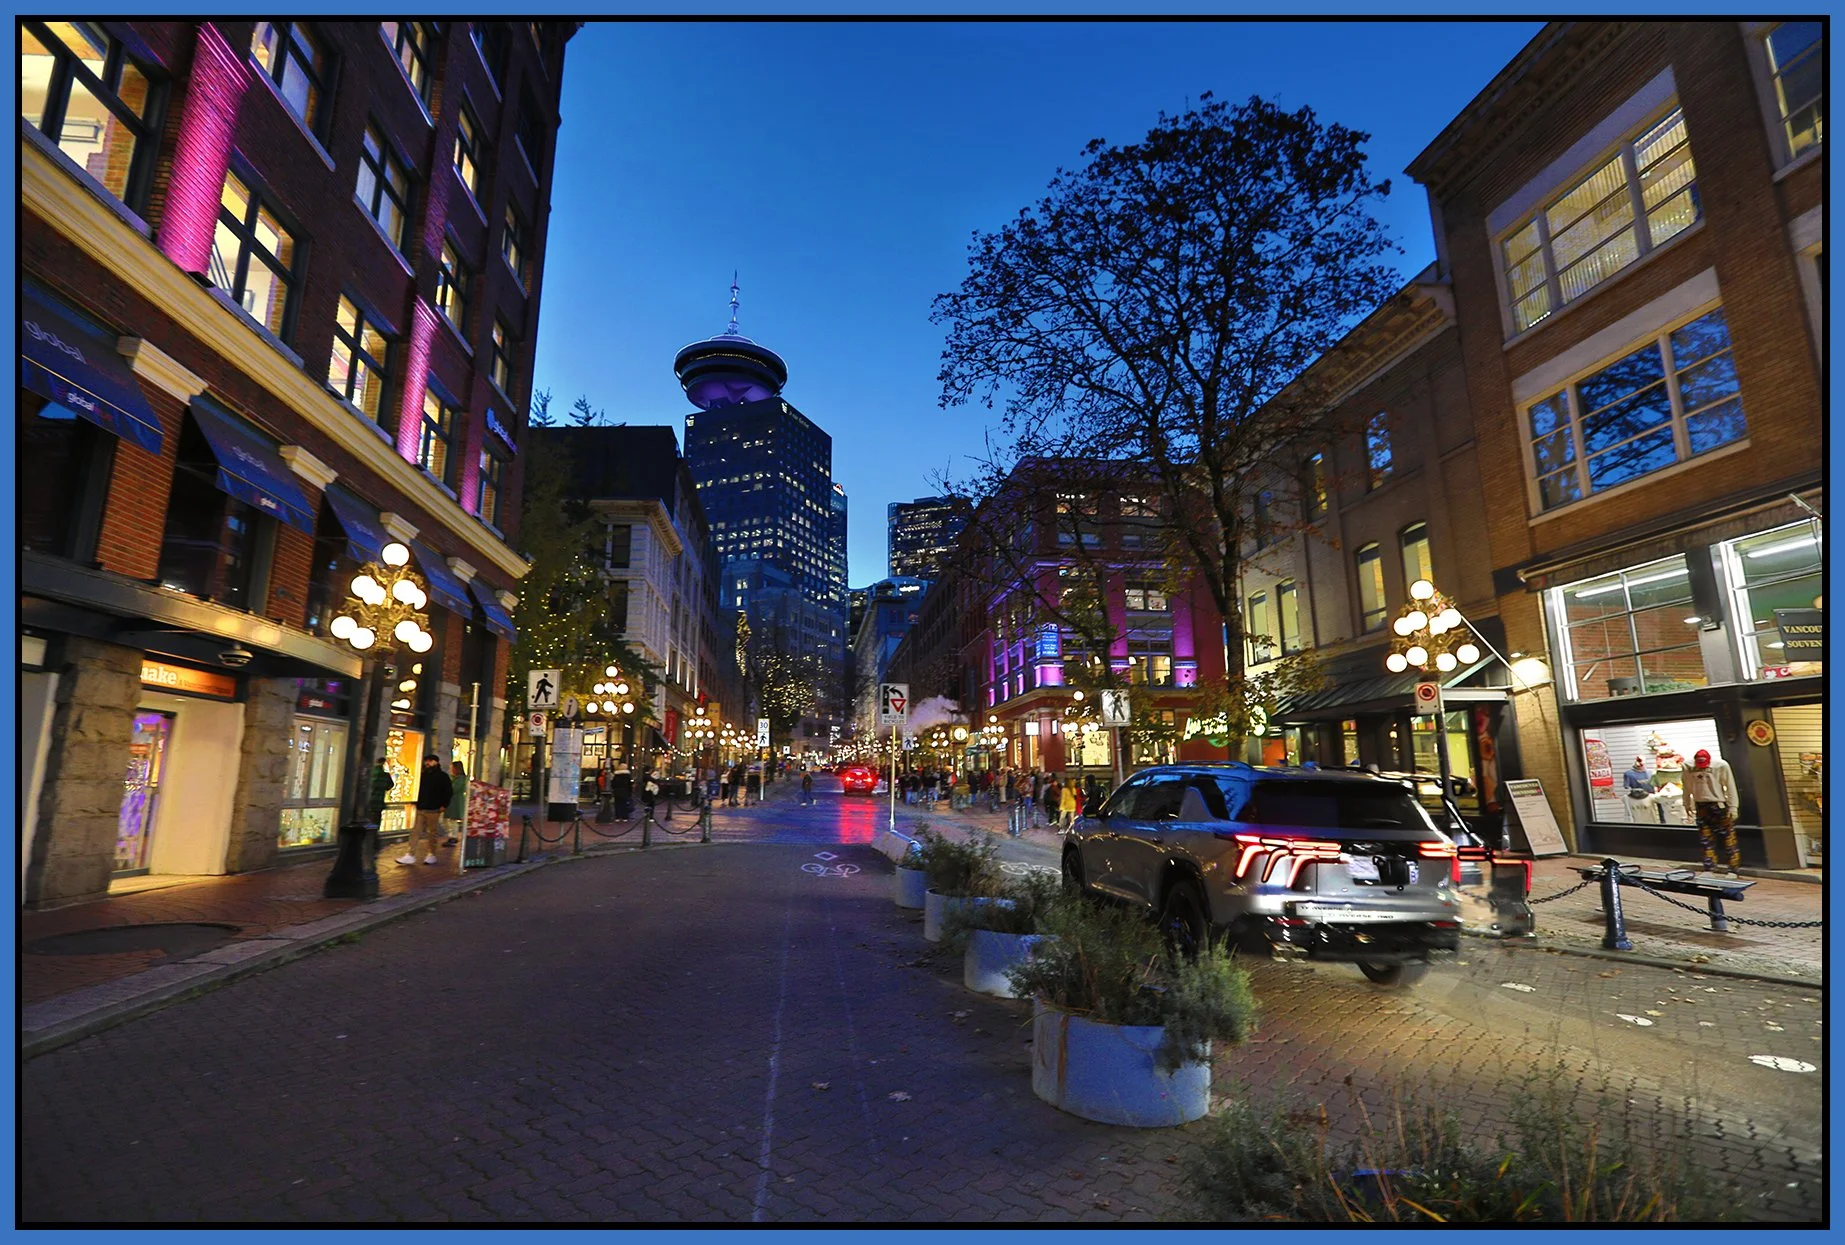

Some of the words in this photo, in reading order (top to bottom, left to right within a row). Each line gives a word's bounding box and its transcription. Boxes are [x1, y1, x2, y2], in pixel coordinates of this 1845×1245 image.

[24, 320, 87, 365] global
[67, 392, 95, 412] global
[760, 721, 769, 729] 30
